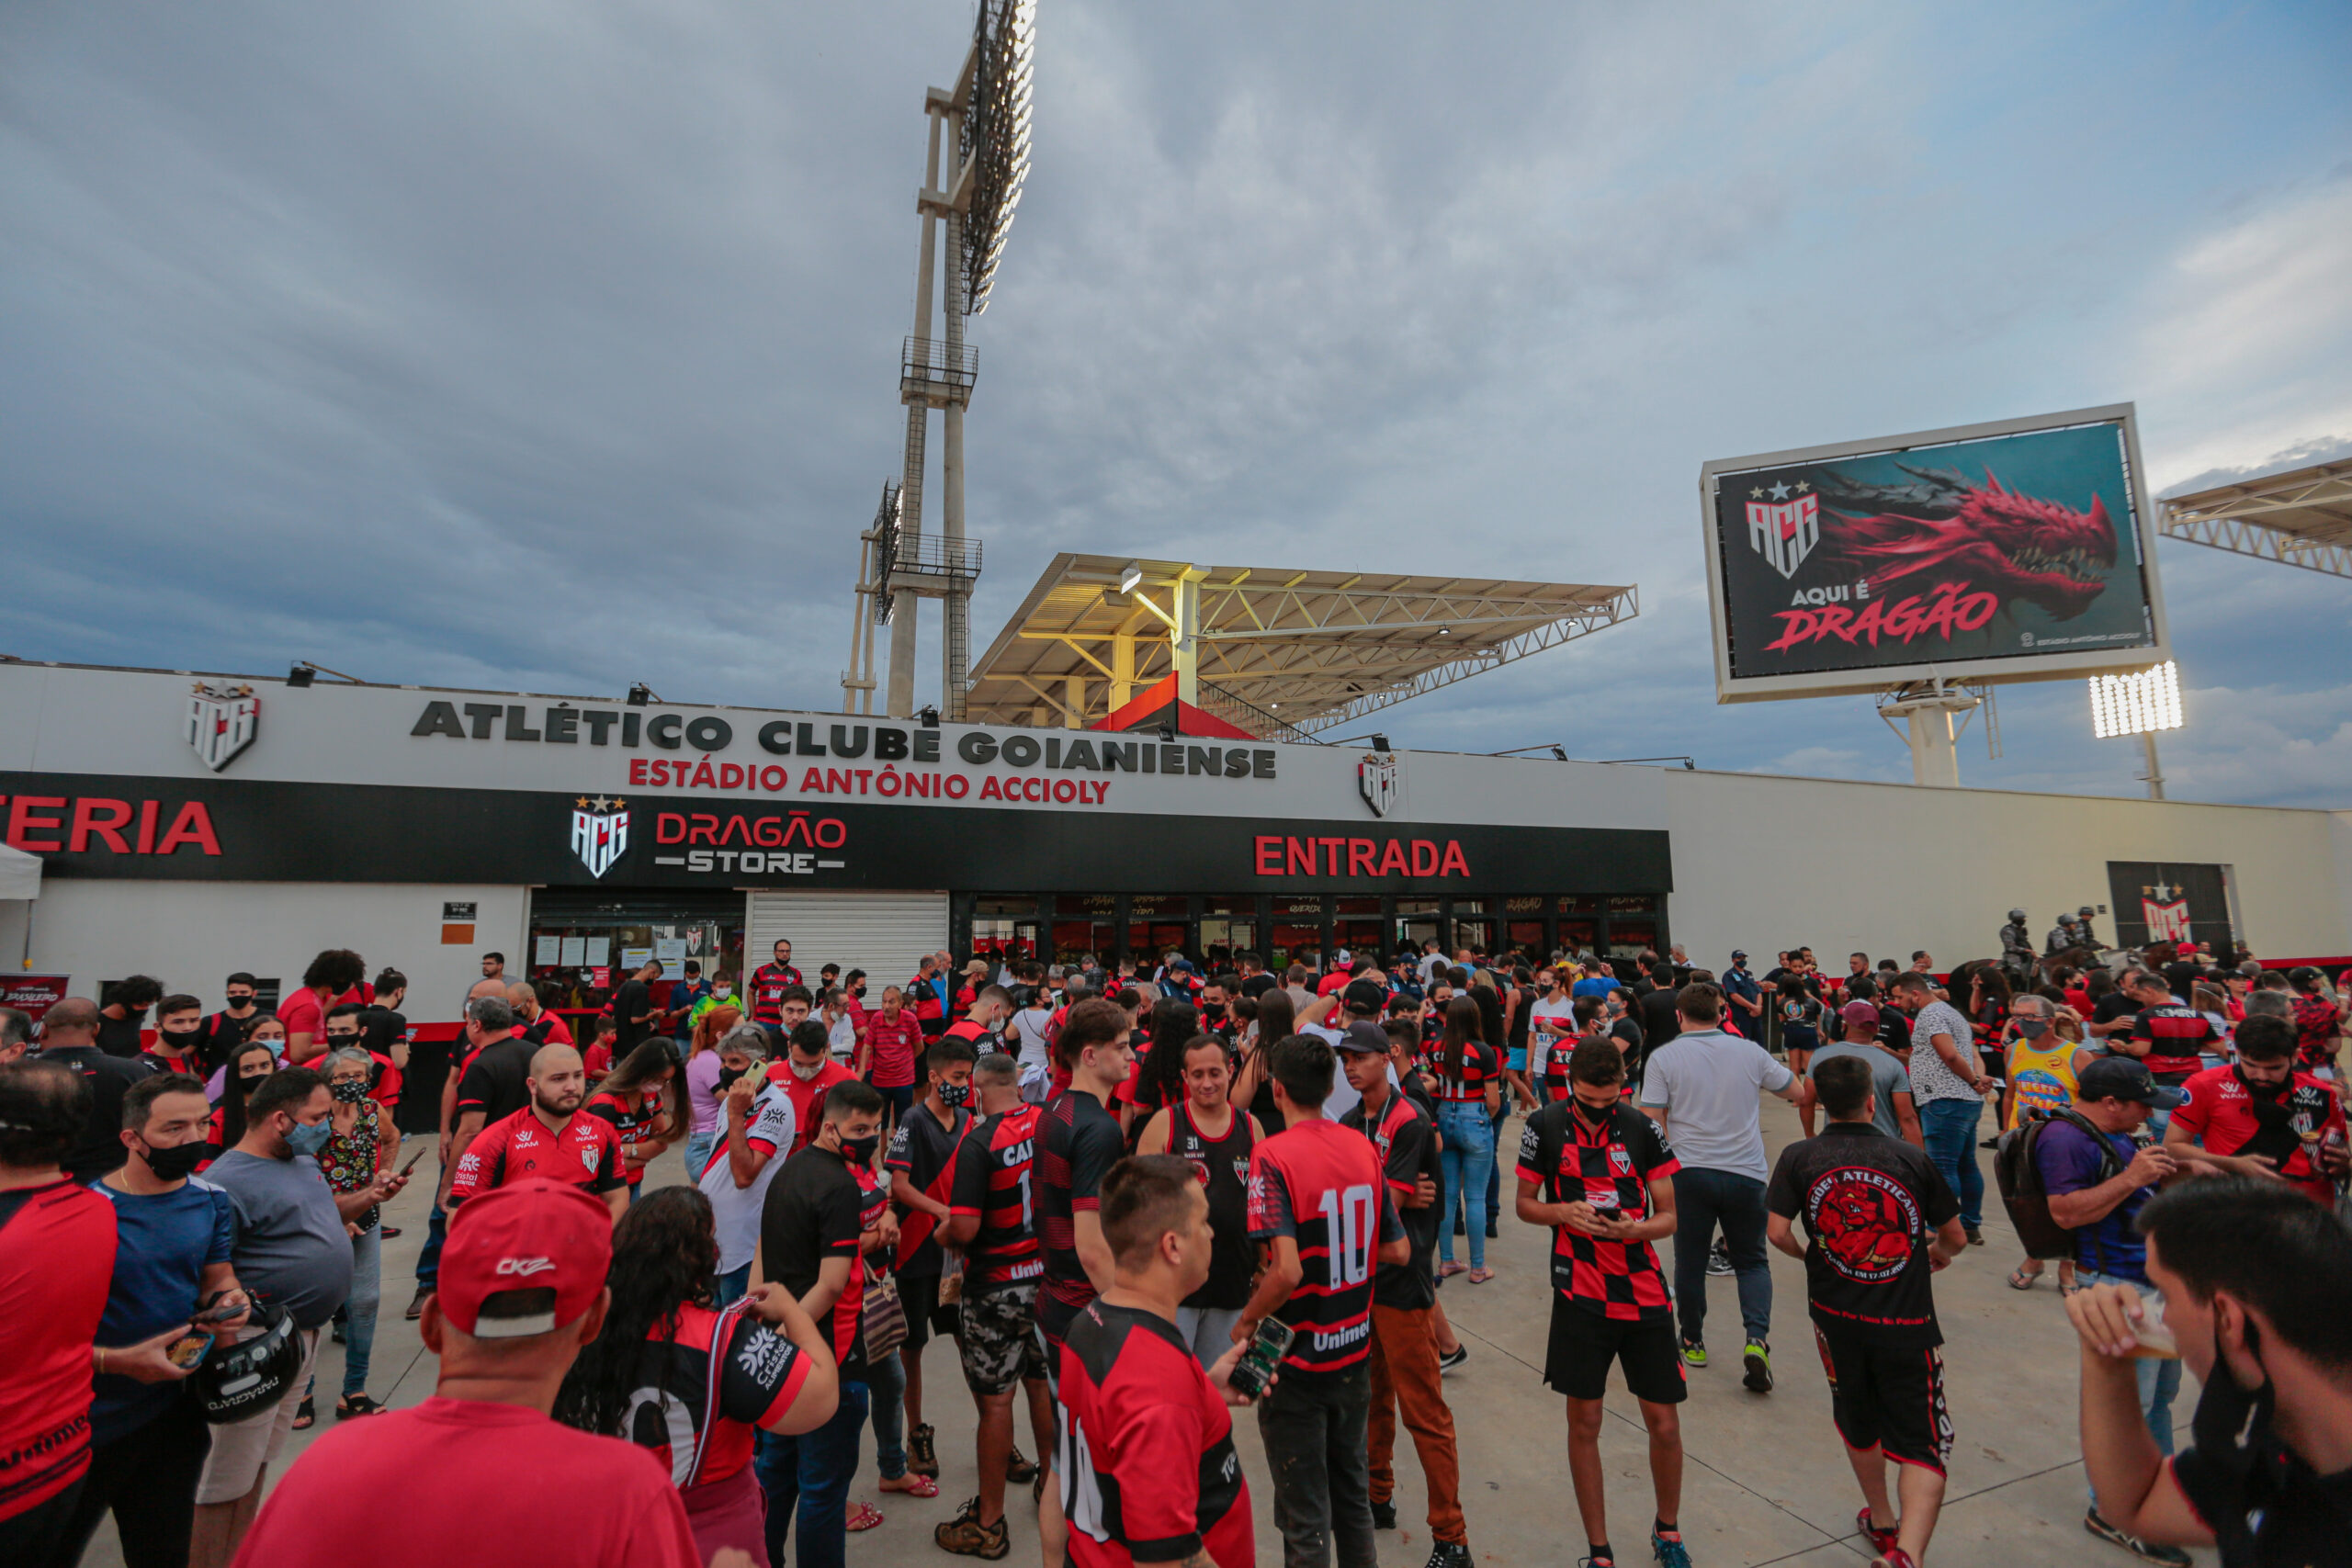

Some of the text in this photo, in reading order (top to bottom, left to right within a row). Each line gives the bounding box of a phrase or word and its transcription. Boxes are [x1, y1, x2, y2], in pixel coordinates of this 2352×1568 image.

[1792, 580, 1869, 606] AQUI É
[1760, 581, 1998, 656] DRAGÃO
[410, 700, 1276, 778] ATLÉTICO CLUBE GOIANIENSE
[628, 753, 1110, 804] ESTÁDIO ANTÔNIO ACCIOLY
[656, 811, 846, 849] DRAGÃO
[688, 850, 815, 874] STORE
[1255, 835, 1470, 877] ENTRADA
[2293, 1097, 2323, 1106] WAM
[515, 1140, 539, 1150] WAM
[575, 1134, 598, 1142] WAM
[1187, 1136, 1198, 1149] 31
[1843, 1171, 1919, 1235] ATLETICANOS
[1318, 1184, 1374, 1291] 10
[764, 1345, 794, 1392] ALIMENTOS
